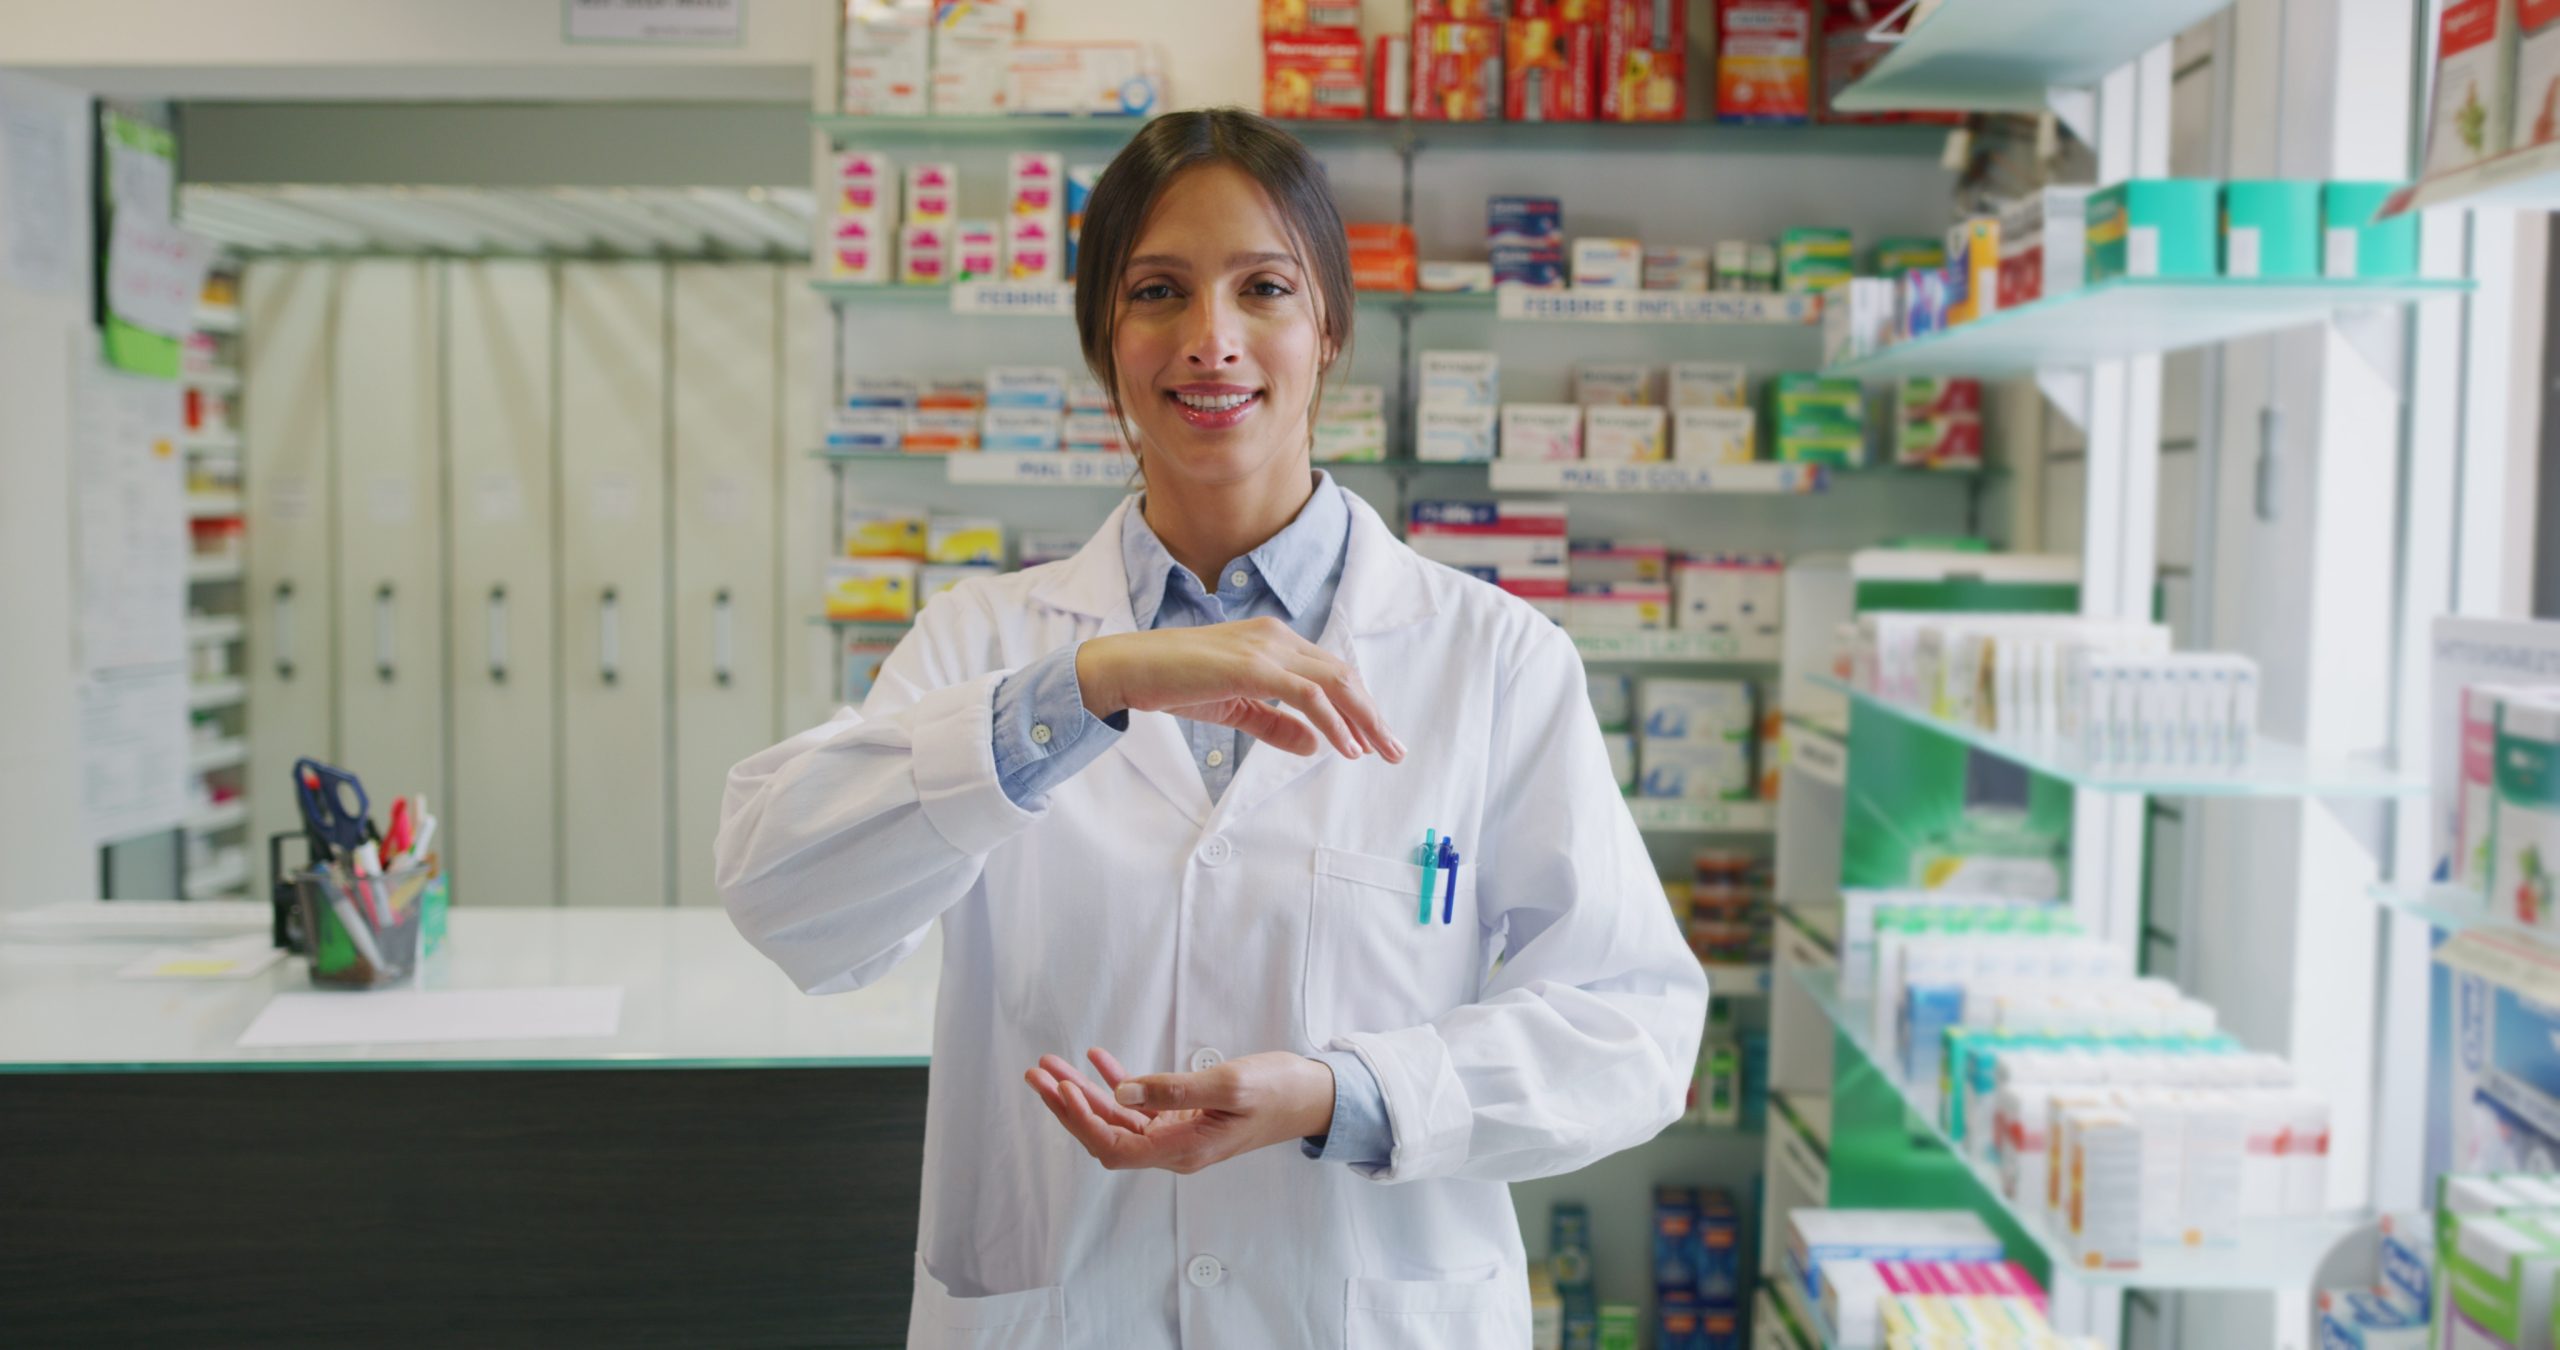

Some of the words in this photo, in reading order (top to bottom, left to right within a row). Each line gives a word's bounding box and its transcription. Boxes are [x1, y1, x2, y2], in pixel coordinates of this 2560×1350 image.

[1524, 295, 1606, 312] FEBBRE
[1635, 297, 1765, 317] INFLUENZA
[1561, 467, 1606, 485] MAL
[1615, 468, 1641, 486] DI
[1647, 468, 1713, 488] GOLA
